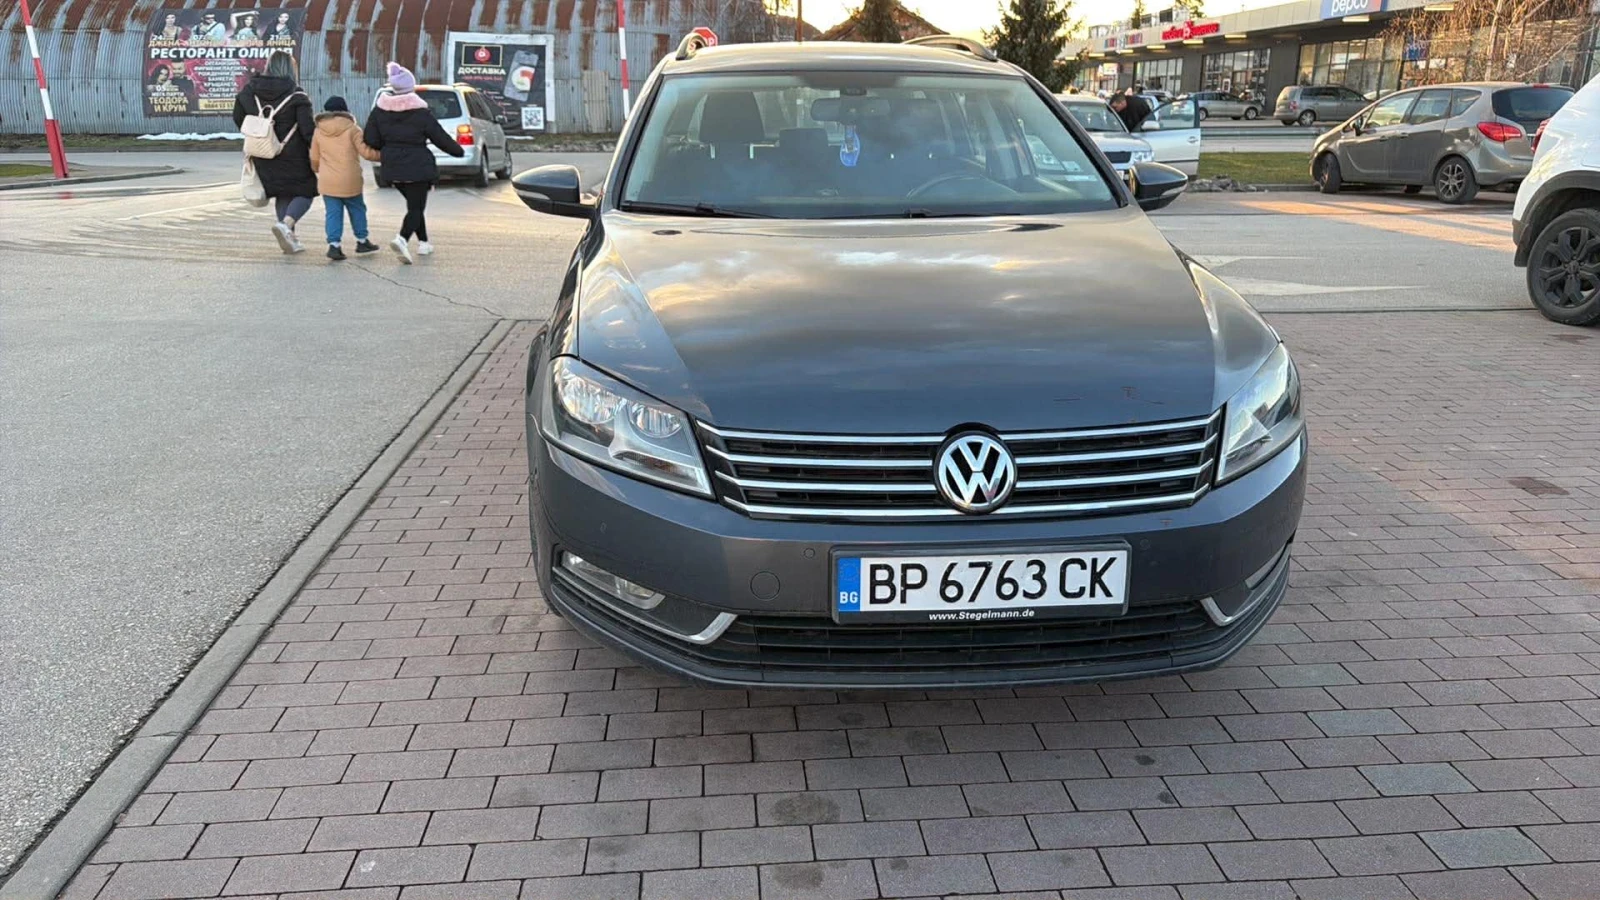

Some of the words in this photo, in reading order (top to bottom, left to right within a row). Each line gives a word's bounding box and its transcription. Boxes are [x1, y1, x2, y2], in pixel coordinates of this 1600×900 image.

[1331, 0, 1368, 16] pepco
[266, 39, 296, 47] ЯНИЦА
[151, 48, 238, 59] РЕСТОРАНТ
[457, 66, 506, 75] ДОСТАВКА
[148, 97, 189, 105] ТЕОДОРА
[154, 104, 163, 113] И
[164, 104, 187, 113] КРУМ
[868, 562, 928, 605] BP
[939, 559, 1048, 604] 6763
[1058, 556, 1118, 599] CK
[839, 591, 859, 604] BG
[928, 608, 1036, 621] www.Stegelmann.de
